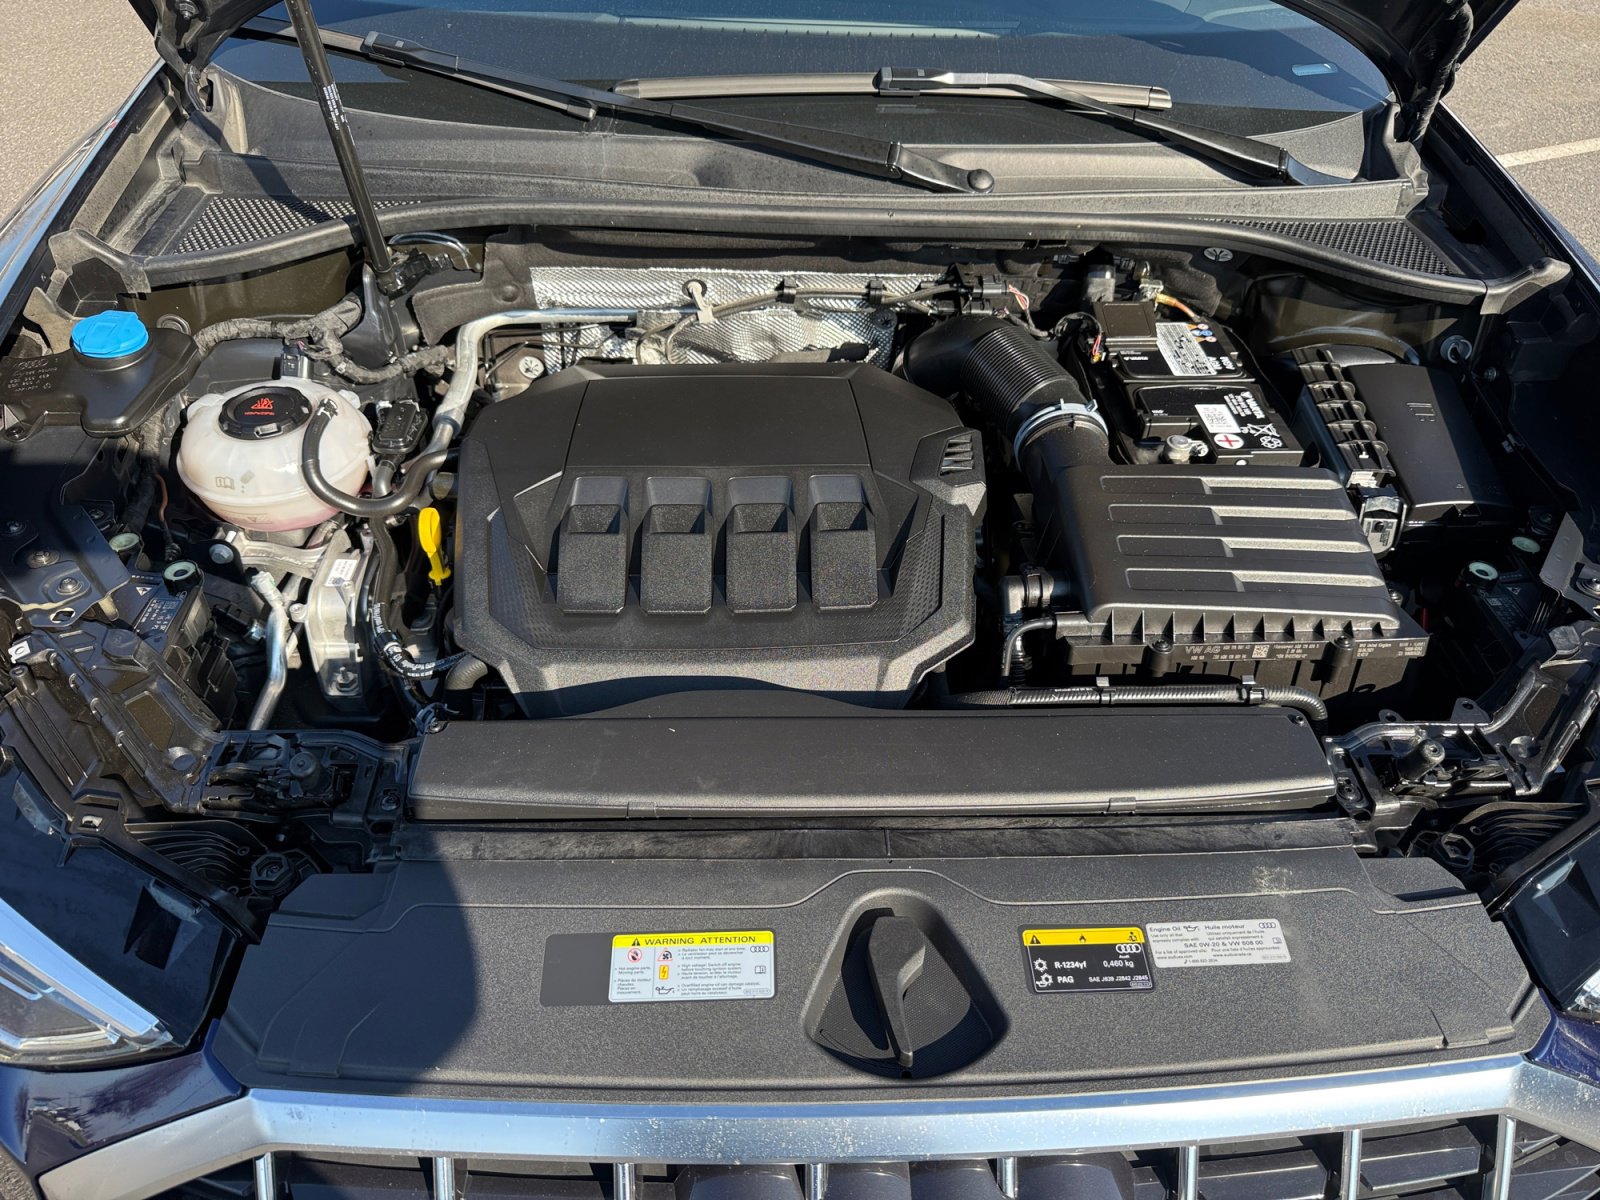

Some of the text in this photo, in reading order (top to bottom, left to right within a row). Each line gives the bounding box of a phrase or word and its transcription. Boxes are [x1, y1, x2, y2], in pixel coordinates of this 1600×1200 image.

[1185, 646, 1204, 654] VW
[1204, 645, 1221, 653] AG
[1054, 960, 1087, 970] R-1234yf
[1125, 960, 1134, 968] kg
